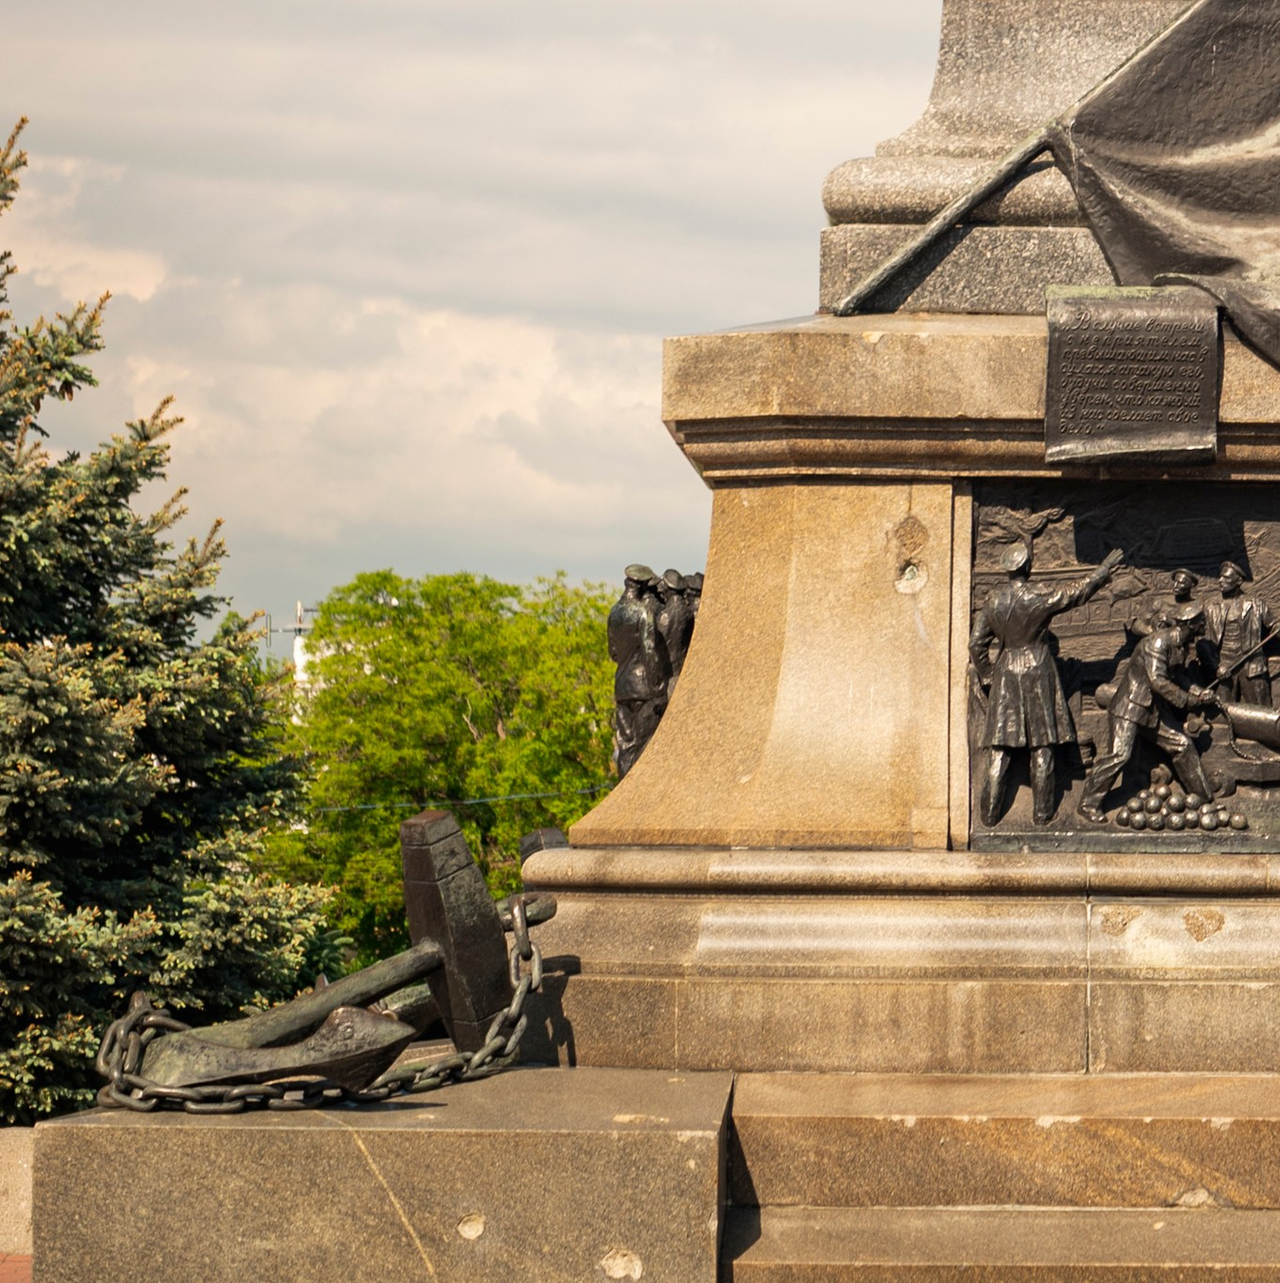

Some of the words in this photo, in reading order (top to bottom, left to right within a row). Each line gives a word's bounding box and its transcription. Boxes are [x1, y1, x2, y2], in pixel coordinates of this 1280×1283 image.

[1093, 321, 1141, 336] случае
[1145, 318, 1206, 337] встречи
[1119, 364, 1175, 382] атакую
[1113, 375, 1201, 397] совершенно
